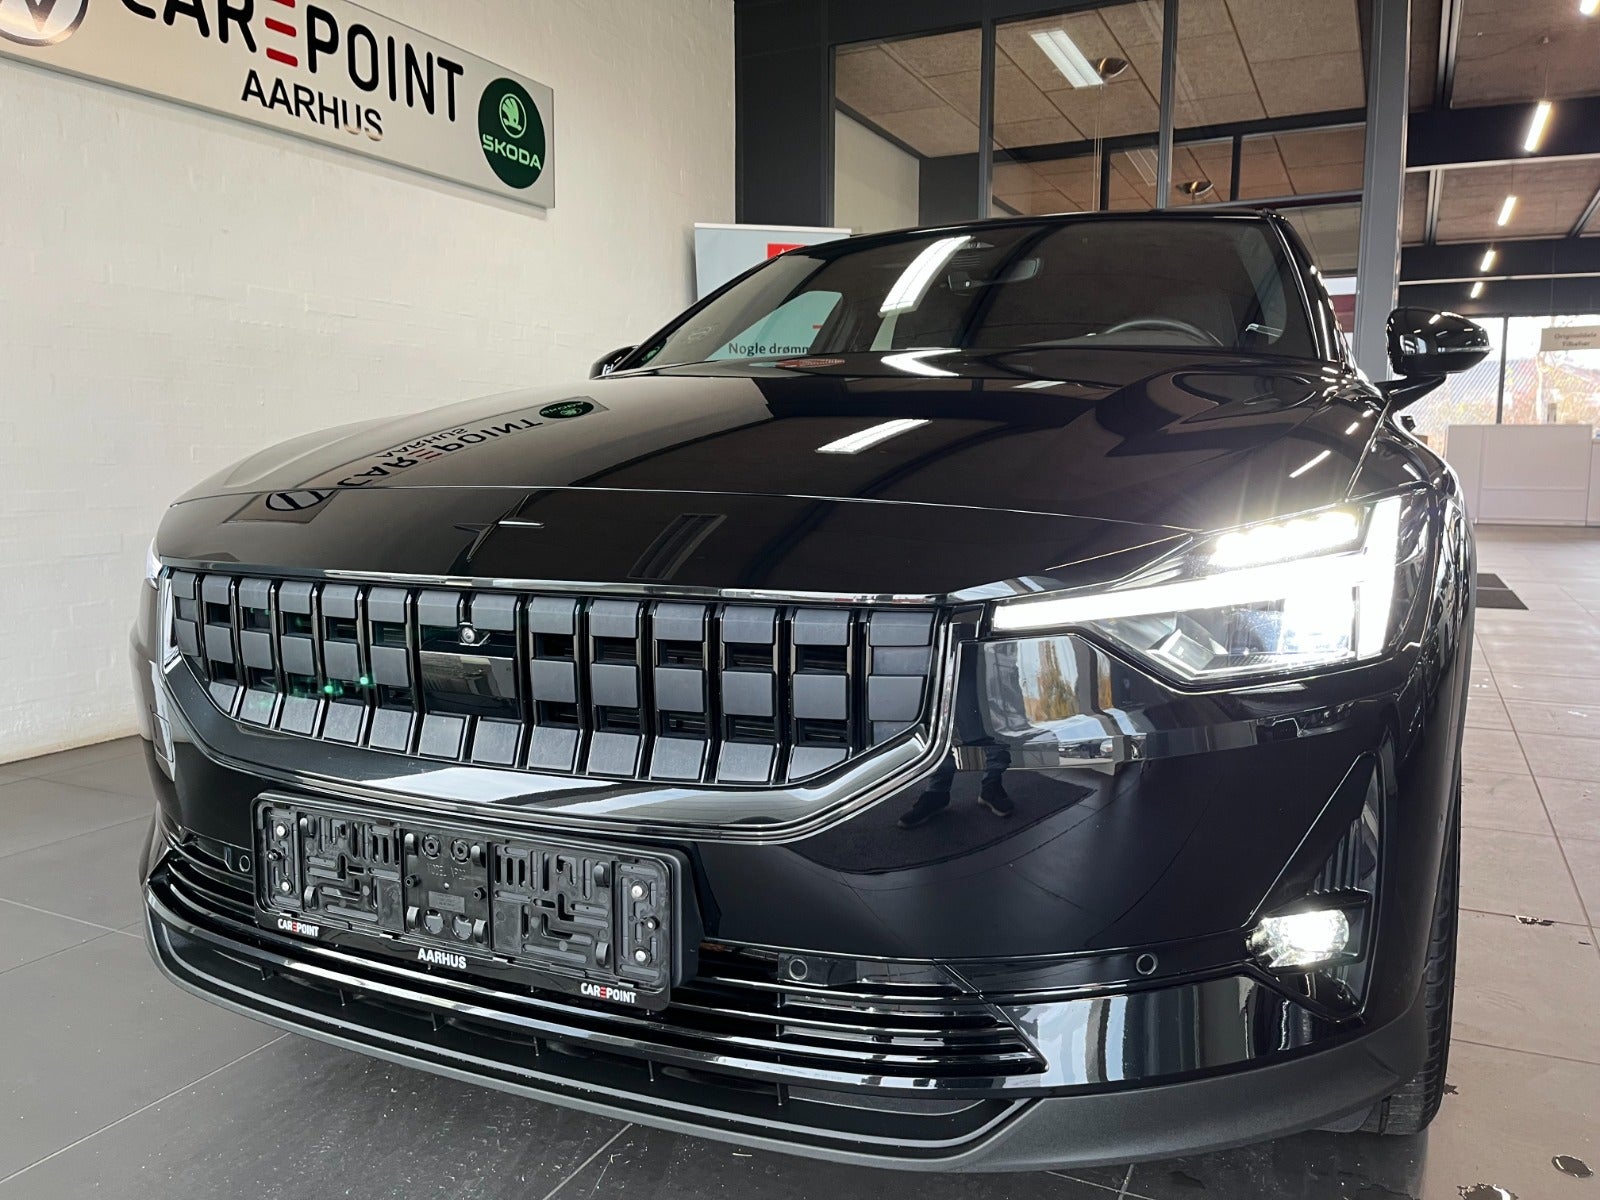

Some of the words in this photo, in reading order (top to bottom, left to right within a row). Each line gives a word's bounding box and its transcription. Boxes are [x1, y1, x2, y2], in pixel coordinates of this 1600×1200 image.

[122, 0, 464, 122] REPOINT
[241, 68, 384, 141] AARHUS
[482, 133, 542, 171] SKODA
[728, 342, 767, 356] Nogle
[277, 918, 320, 938] CAREPOINT
[417, 947, 467, 969] AARHUS
[580, 982, 637, 1004] CAREPOINT
